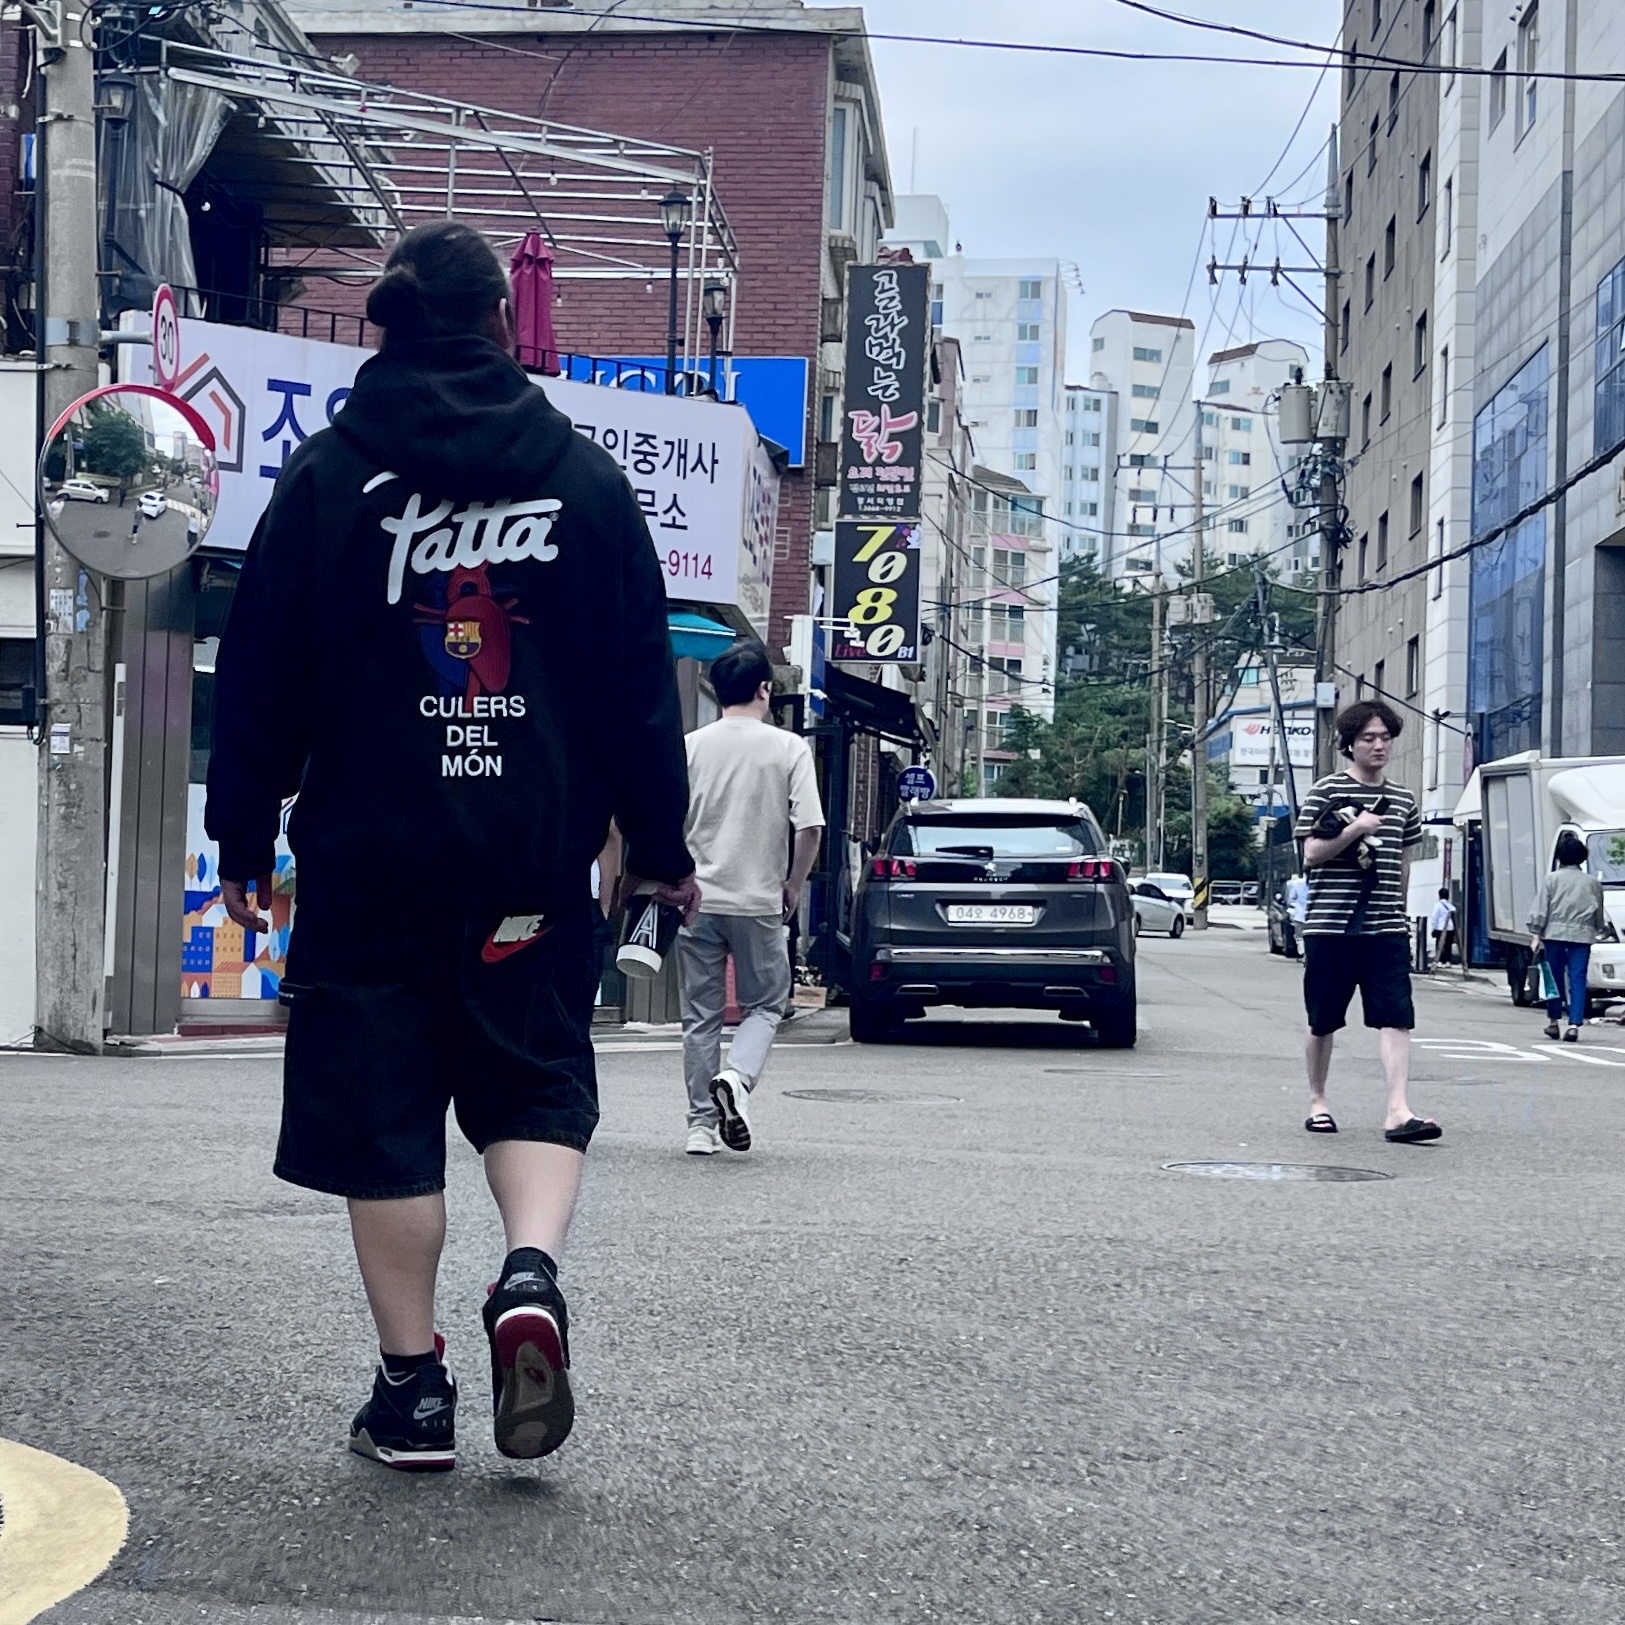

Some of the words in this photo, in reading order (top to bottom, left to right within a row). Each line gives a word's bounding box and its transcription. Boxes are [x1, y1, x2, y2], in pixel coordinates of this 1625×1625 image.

[160, 314, 174, 366] 30
[864, 269, 909, 402] 골라먹는
[847, 403, 918, 465] 닭
[896, 645, 915, 659] B1
[418, 695, 527, 718] CULERS
[446, 724, 499, 747] DEL
[441, 748, 503, 777] MÓN
[904, 772, 926, 785] 셀프
[900, 784, 931, 800] 빨래방
[989, 906, 1026, 920] 4968
[492, 913, 545, 944] NIKE
[417, 1396, 446, 1412] NIKE
[421, 1419, 448, 1428] AIR
